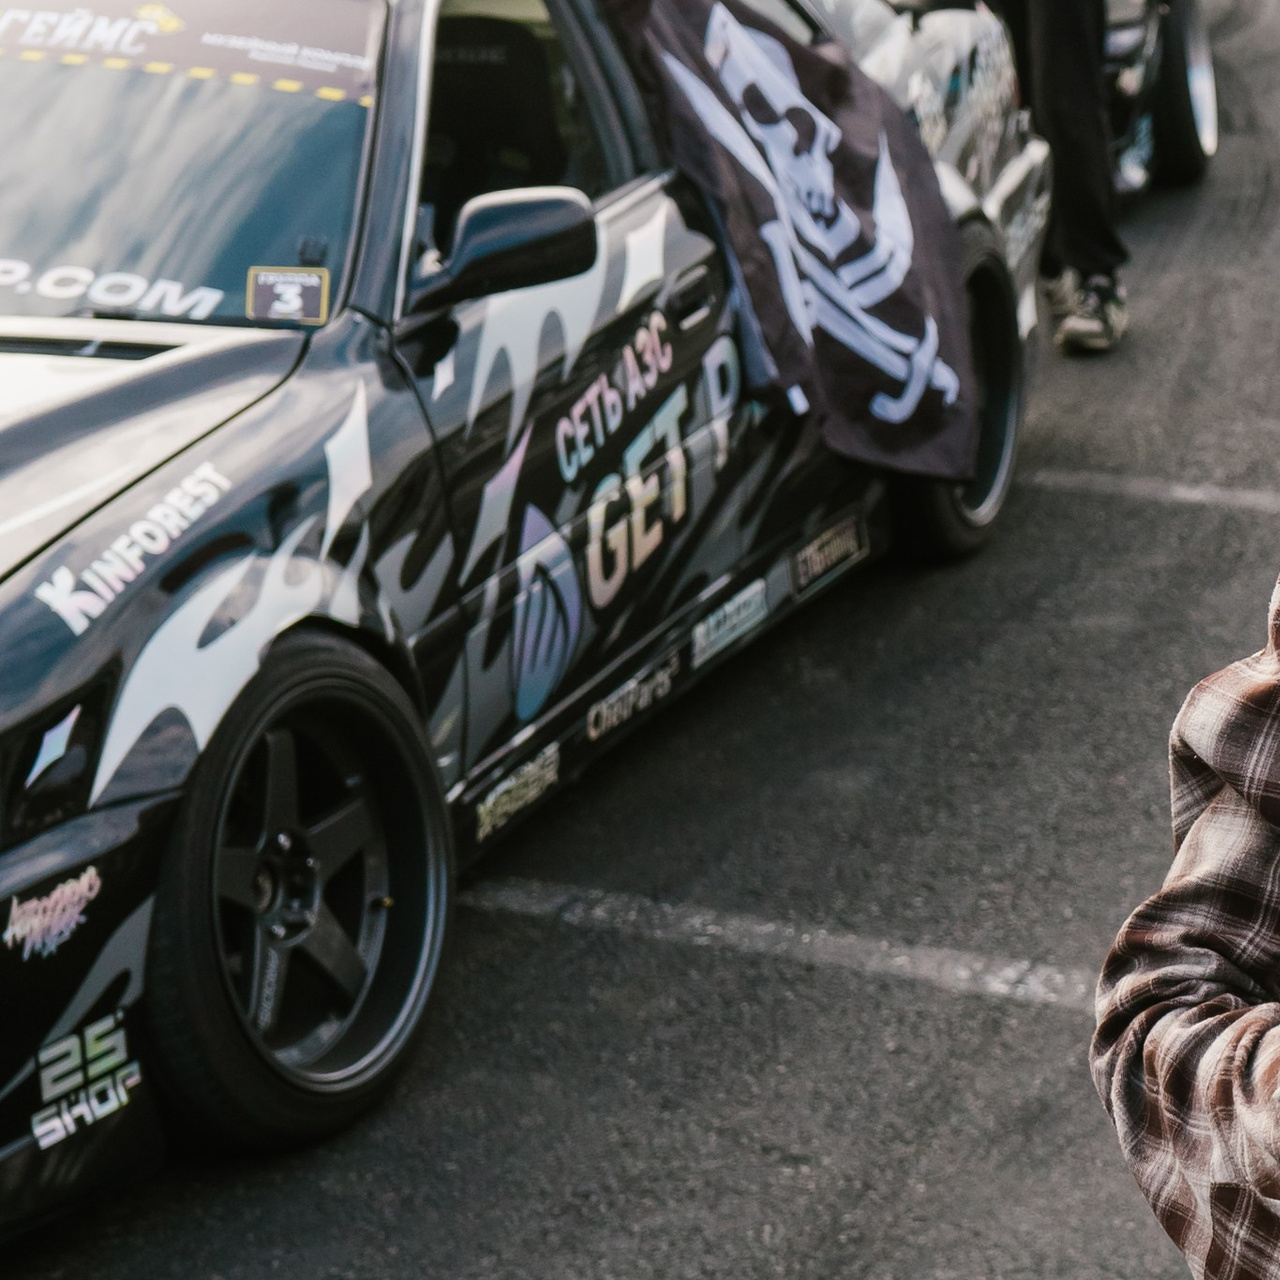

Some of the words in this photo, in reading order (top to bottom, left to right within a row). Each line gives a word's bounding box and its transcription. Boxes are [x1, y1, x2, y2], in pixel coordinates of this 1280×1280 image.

[271, 283, 303, 313] 3
[555, 371, 624, 483] СЕТЬ
[622, 310, 673, 412] АЗС
[34, 460, 233, 637] KINFOREST
[586, 381, 689, 610] GET
[31, 1059, 142, 1151] SHOP
[38, 1013, 128, 1105] 25
